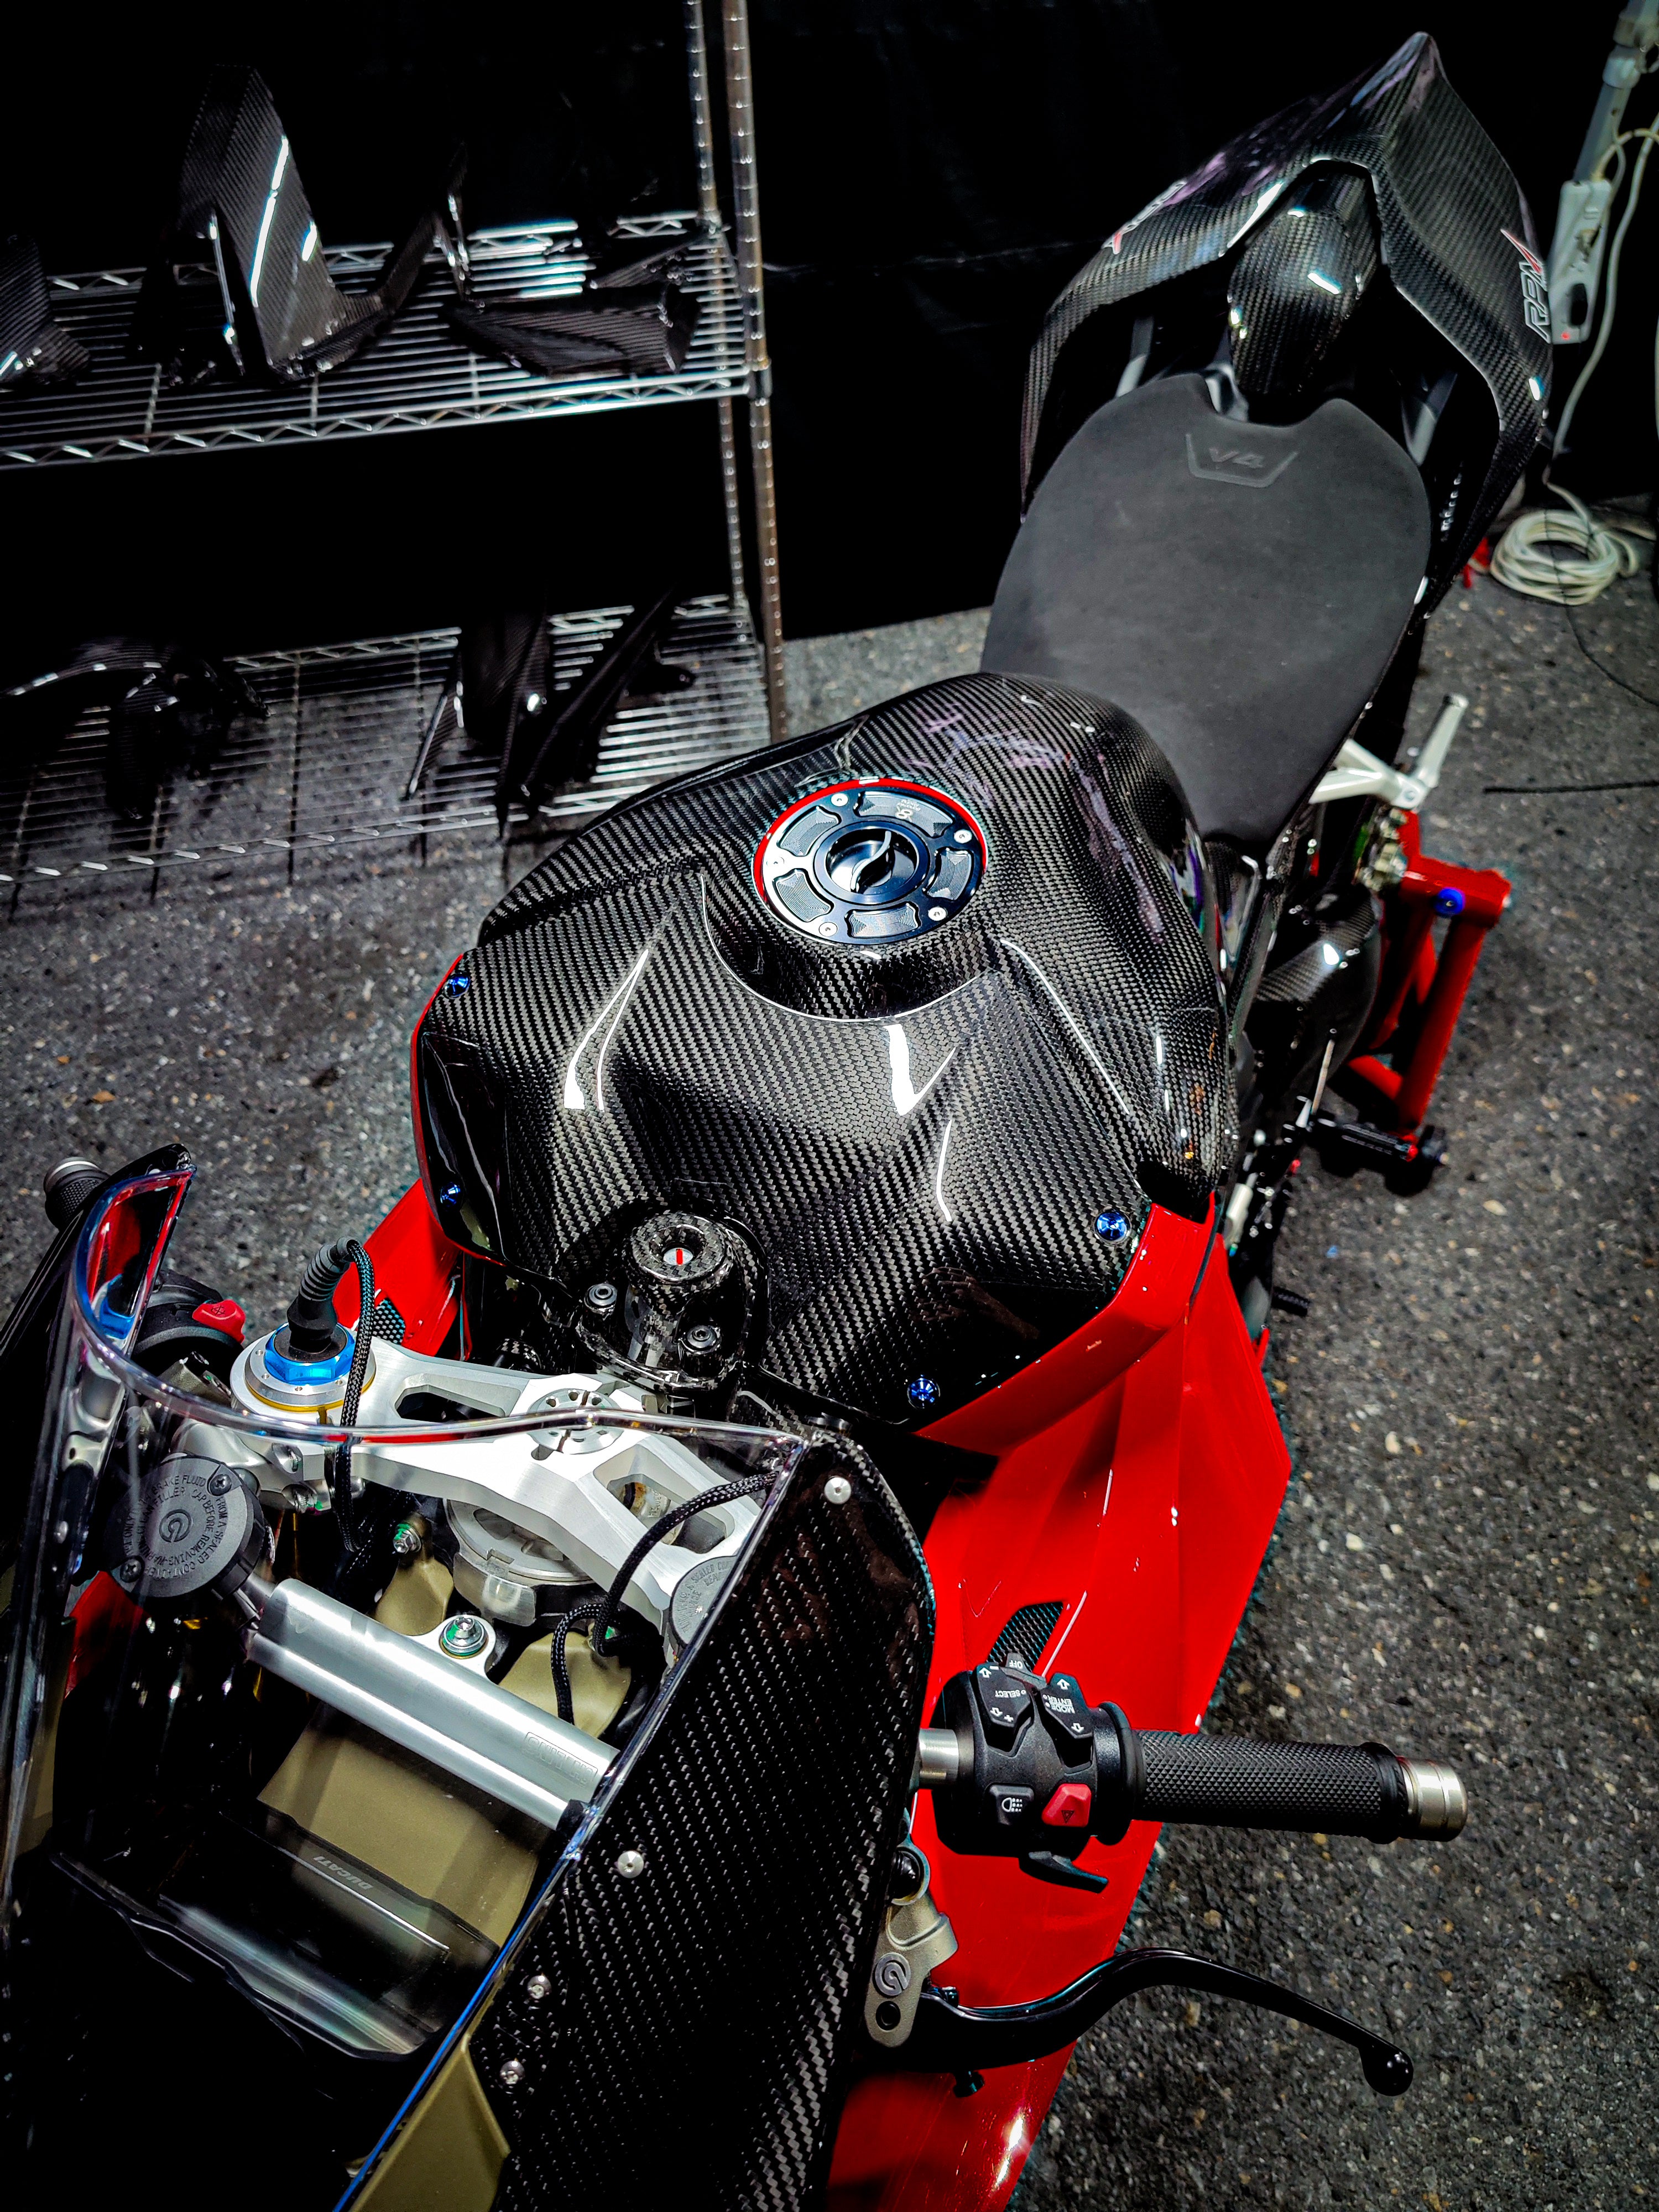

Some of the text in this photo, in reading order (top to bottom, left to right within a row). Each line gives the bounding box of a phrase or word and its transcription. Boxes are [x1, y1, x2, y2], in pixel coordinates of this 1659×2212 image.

[1209, 447, 1265, 468] V4
[182, 1474, 207, 1487] FLUID
[153, 1486, 185, 1506] FILLER
[191, 1489, 207, 1503] CAP
[202, 1499, 216, 1532] BEFORE
[215, 1496, 228, 1519] FROM
[199, 1530, 225, 1564] SEALED
[691, 1563, 715, 1584] SEALED
[1009, 1660, 1023, 1670] OFF
[994, 1689, 1021, 1698] SELECT
[1047, 1694, 1072, 1705] ENTER
[1051, 1704, 1076, 1714] MODE
[313, 1856, 374, 1890] DUCATI
